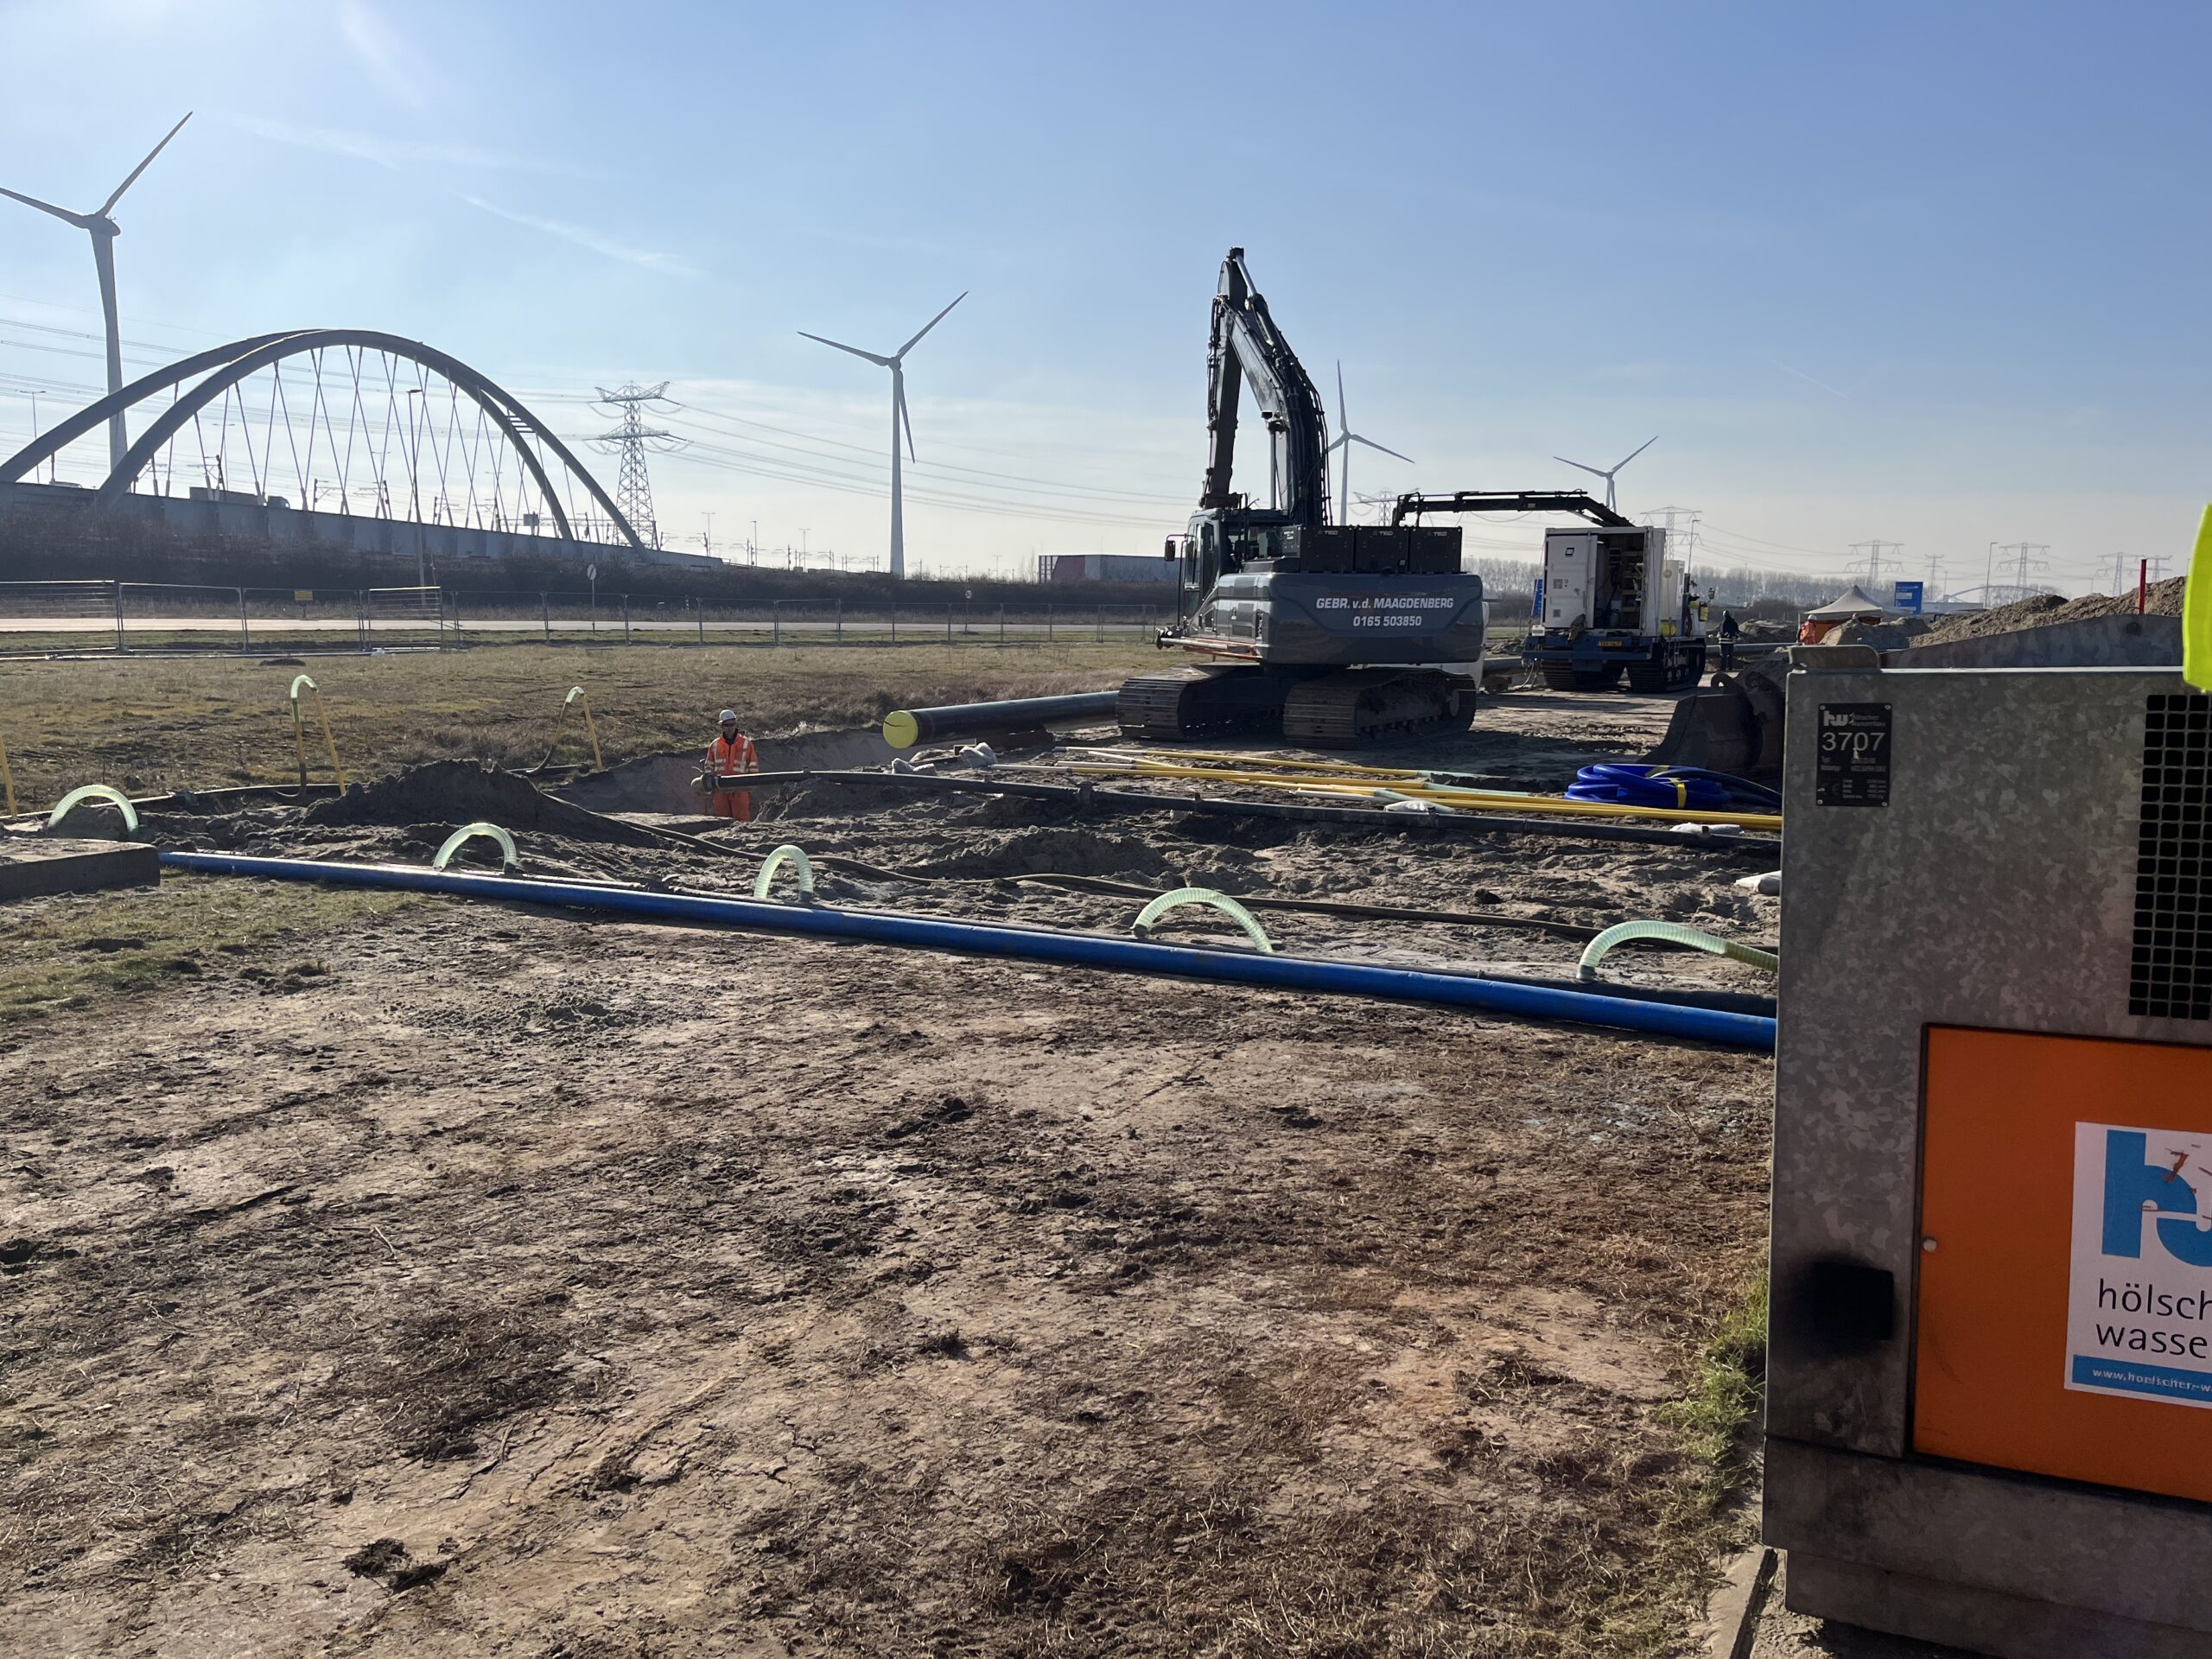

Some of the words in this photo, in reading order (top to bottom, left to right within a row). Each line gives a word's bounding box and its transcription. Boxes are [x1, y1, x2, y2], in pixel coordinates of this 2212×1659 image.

[1316, 598, 1351, 609] GEBR.
[1352, 598, 1371, 609] v.d.
[1373, 597, 1453, 609] MAAGDENBERG
[1353, 615, 1381, 626] 0165
[1383, 615, 1422, 626] 503850
[1821, 732, 1885, 751] 3707
[2098, 1278, 2212, 1320] hölsch
[2095, 1324, 2208, 1359] wasse
[2092, 1369, 2212, 1392] www.hoelscher-w
